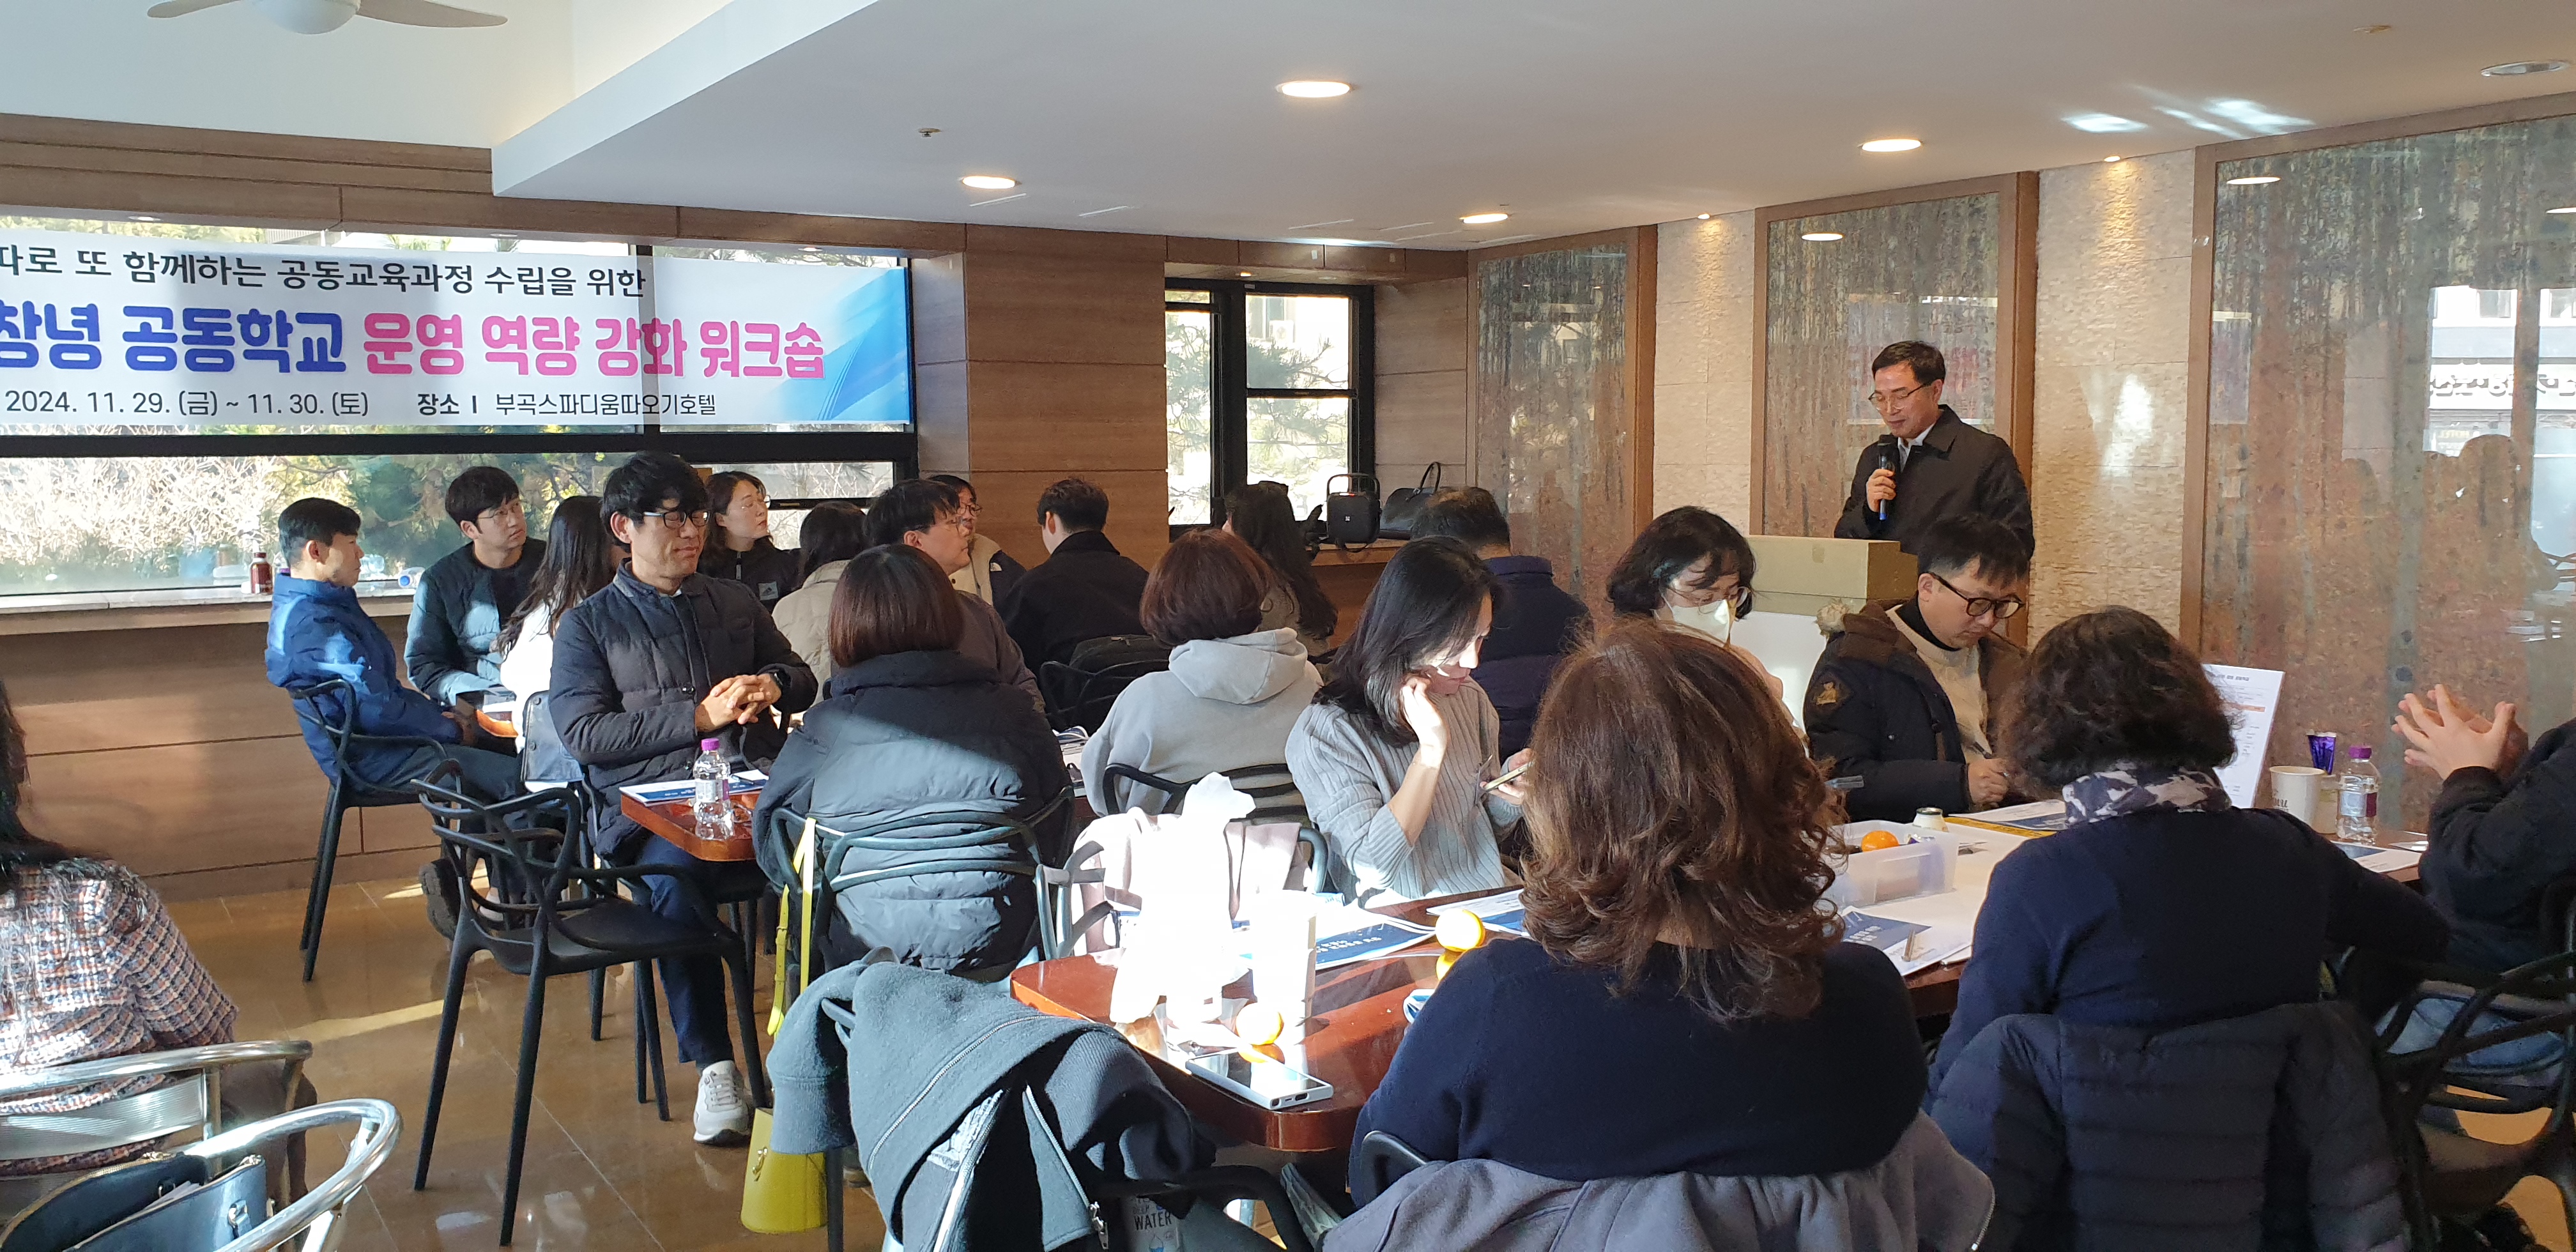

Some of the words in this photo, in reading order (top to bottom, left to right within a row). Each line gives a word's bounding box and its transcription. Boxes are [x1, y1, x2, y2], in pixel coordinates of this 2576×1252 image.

[75, 250, 112, 276] 또
[123, 252, 267, 288] 함께하는
[277, 261, 473, 294] 공동교육과정
[485, 266, 577, 297] 수립을
[586, 268, 647, 298] 위한
[122, 306, 346, 374] 공동학교
[364, 312, 464, 375] 운영
[482, 315, 581, 376] 역량
[595, 317, 687, 377] 강화
[700, 321, 824, 378] 워크숍
[5, 390, 77, 413] 2024.
[88, 392, 124, 413] 11.
[133, 392, 170, 413] 29.
[179, 391, 218, 417] (금)
[248, 393, 282, 415] 11.
[289, 394, 325, 415] 30.
[332, 392, 369, 417] (토)
[418, 393, 460, 416] 장소
[496, 394, 717, 416] 부곡스파디움따오기호텔
[1134, 1210, 1172, 1231] WATER
